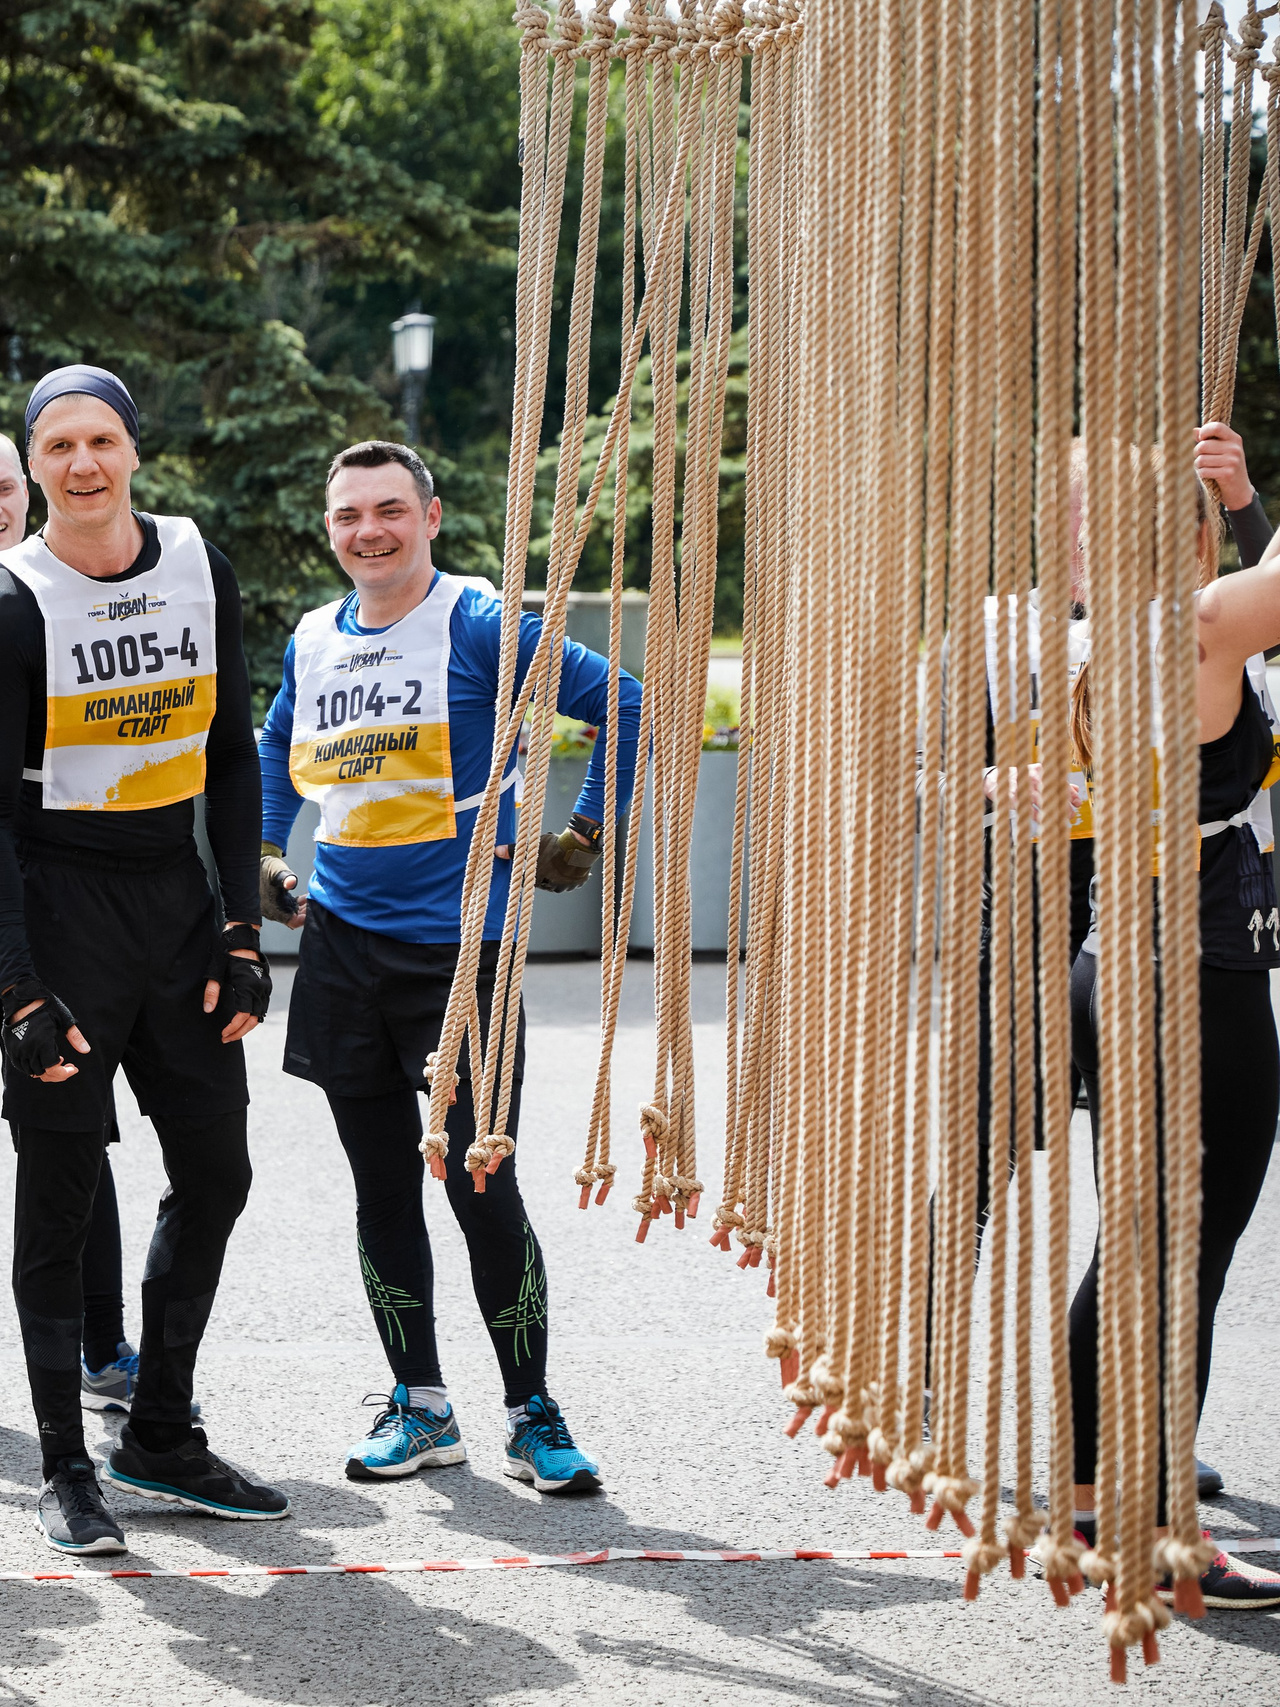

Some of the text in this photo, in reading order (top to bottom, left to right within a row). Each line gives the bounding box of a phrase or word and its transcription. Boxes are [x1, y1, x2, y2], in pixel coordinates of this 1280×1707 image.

[108, 592, 147, 621] URBAN
[71, 627, 199, 685] 1005-4
[349, 646, 387, 673] URBAN
[84, 678, 196, 722] КОМАНДНЫЙ
[316, 679, 423, 731] 1004-2
[117, 713, 172, 738] СТАРТ
[314, 726, 419, 763] КОМАНДНЫЙ
[338, 755, 387, 780] СТАРТ
